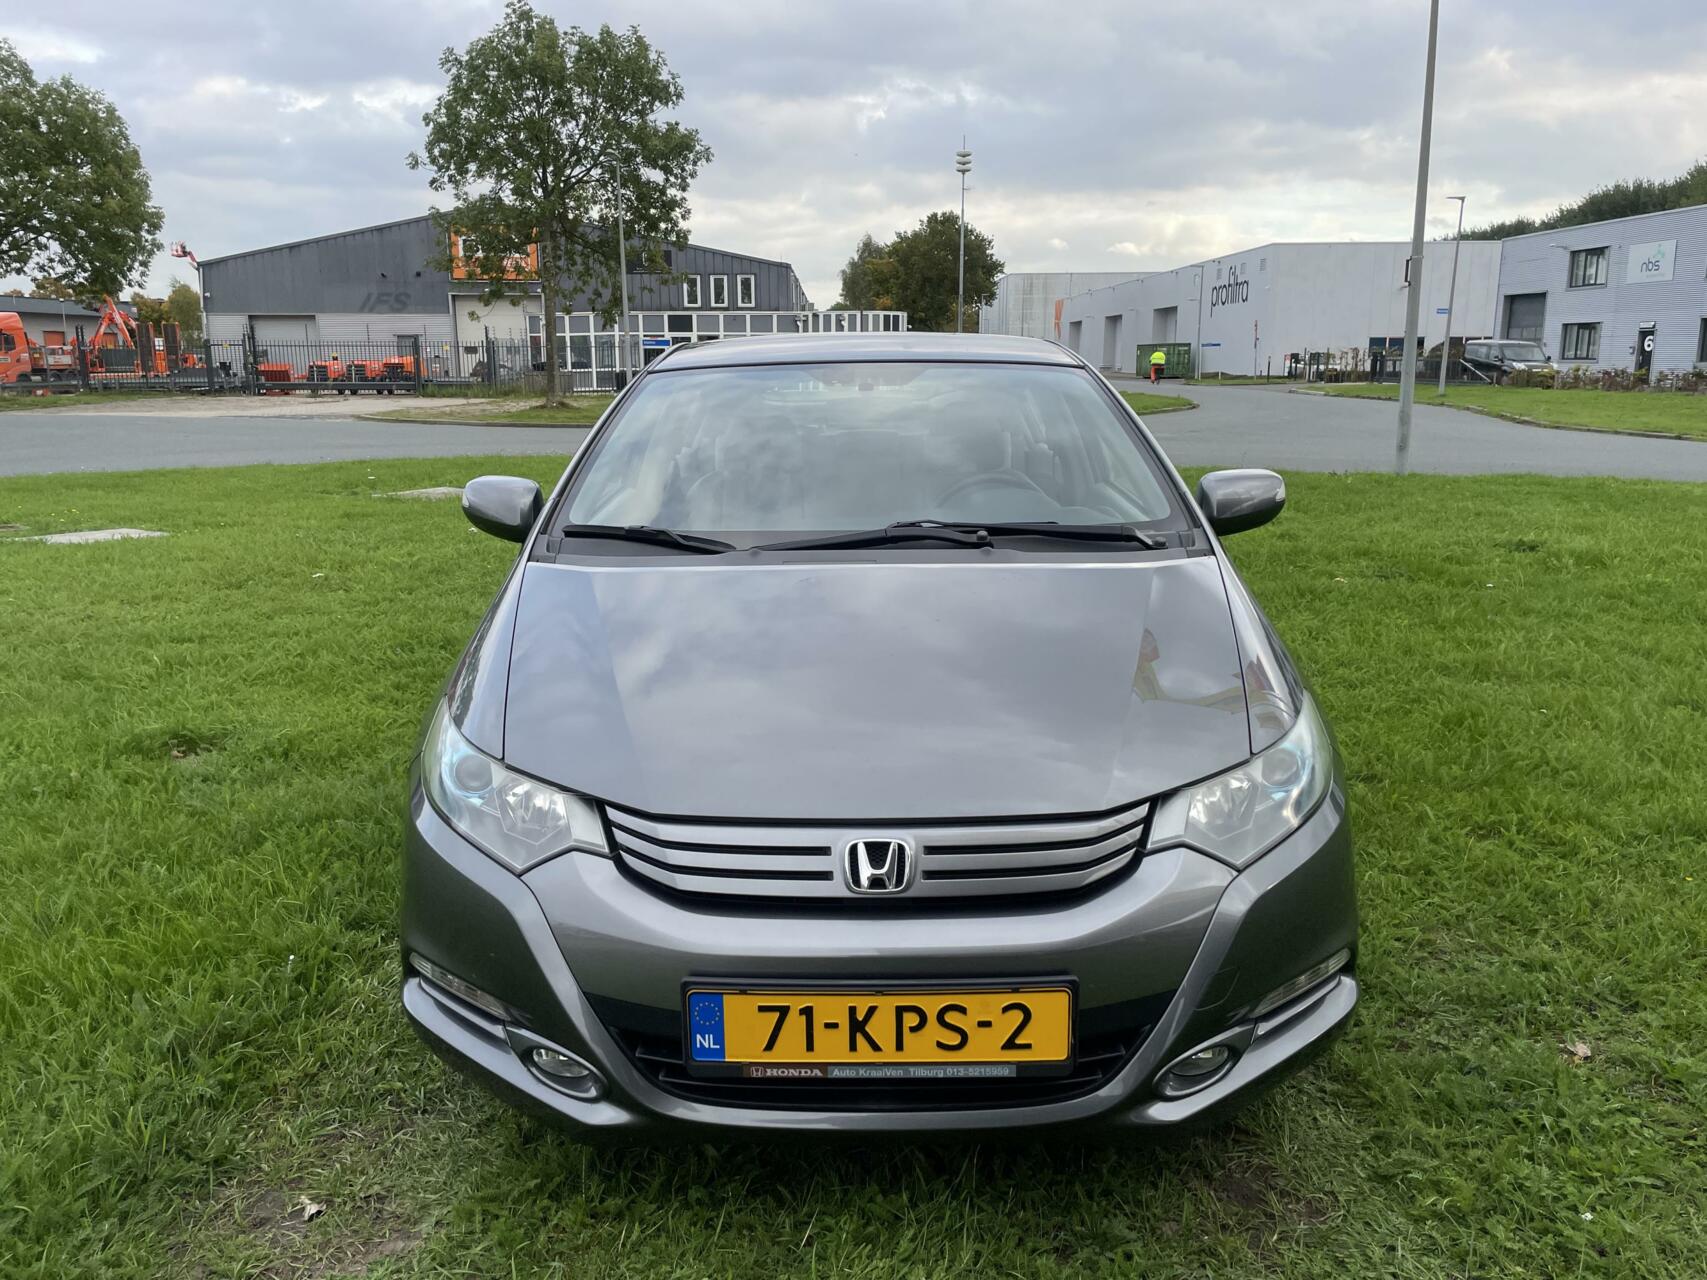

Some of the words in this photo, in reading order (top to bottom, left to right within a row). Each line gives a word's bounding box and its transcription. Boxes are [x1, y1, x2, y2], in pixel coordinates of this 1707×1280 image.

[1640, 257, 1660, 272] nbs
[1210, 265, 1249, 318] profiltra
[359, 292, 411, 313] IFS
[1644, 335, 1654, 351] 6
[757, 1002, 1033, 1053] 71-KPS-2
[696, 1033, 720, 1049] NL
[765, 1068, 823, 1077] HONDA
[832, 1067, 856, 1077] Auto
[908, 1067, 944, 1078] Tilburg
